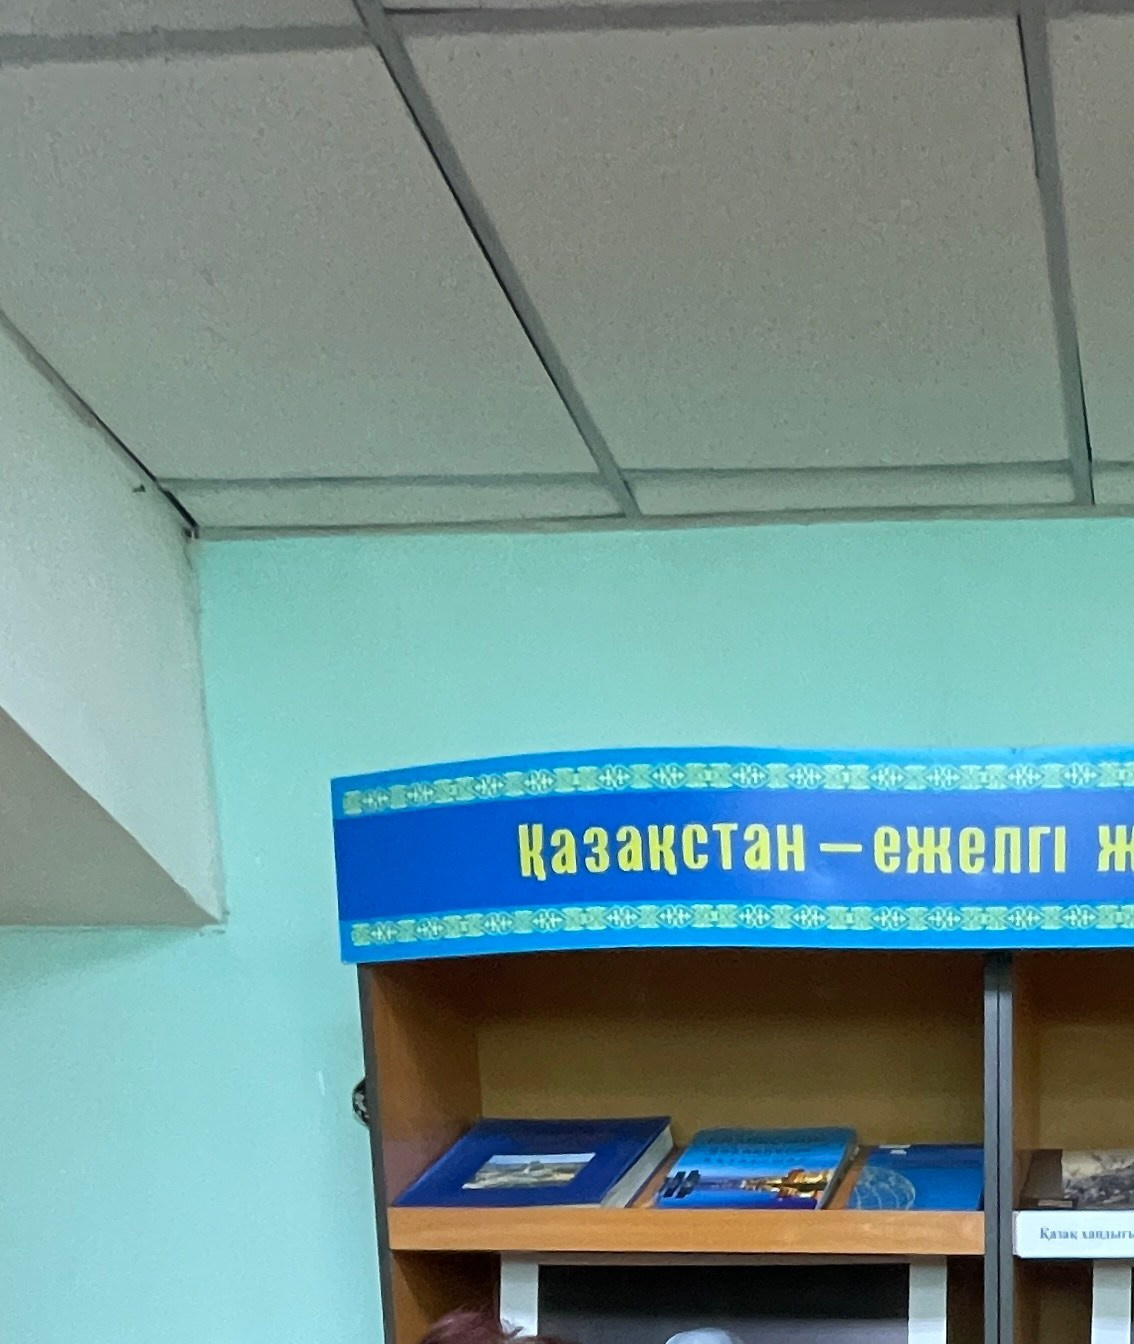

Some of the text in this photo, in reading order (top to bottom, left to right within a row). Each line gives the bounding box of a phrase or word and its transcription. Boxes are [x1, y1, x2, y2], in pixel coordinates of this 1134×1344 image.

[517, 821, 806, 882] Қазақстан
[873, 824, 1068, 875] ежелгі
[1039, 1227, 1078, 1242] Қазақ
